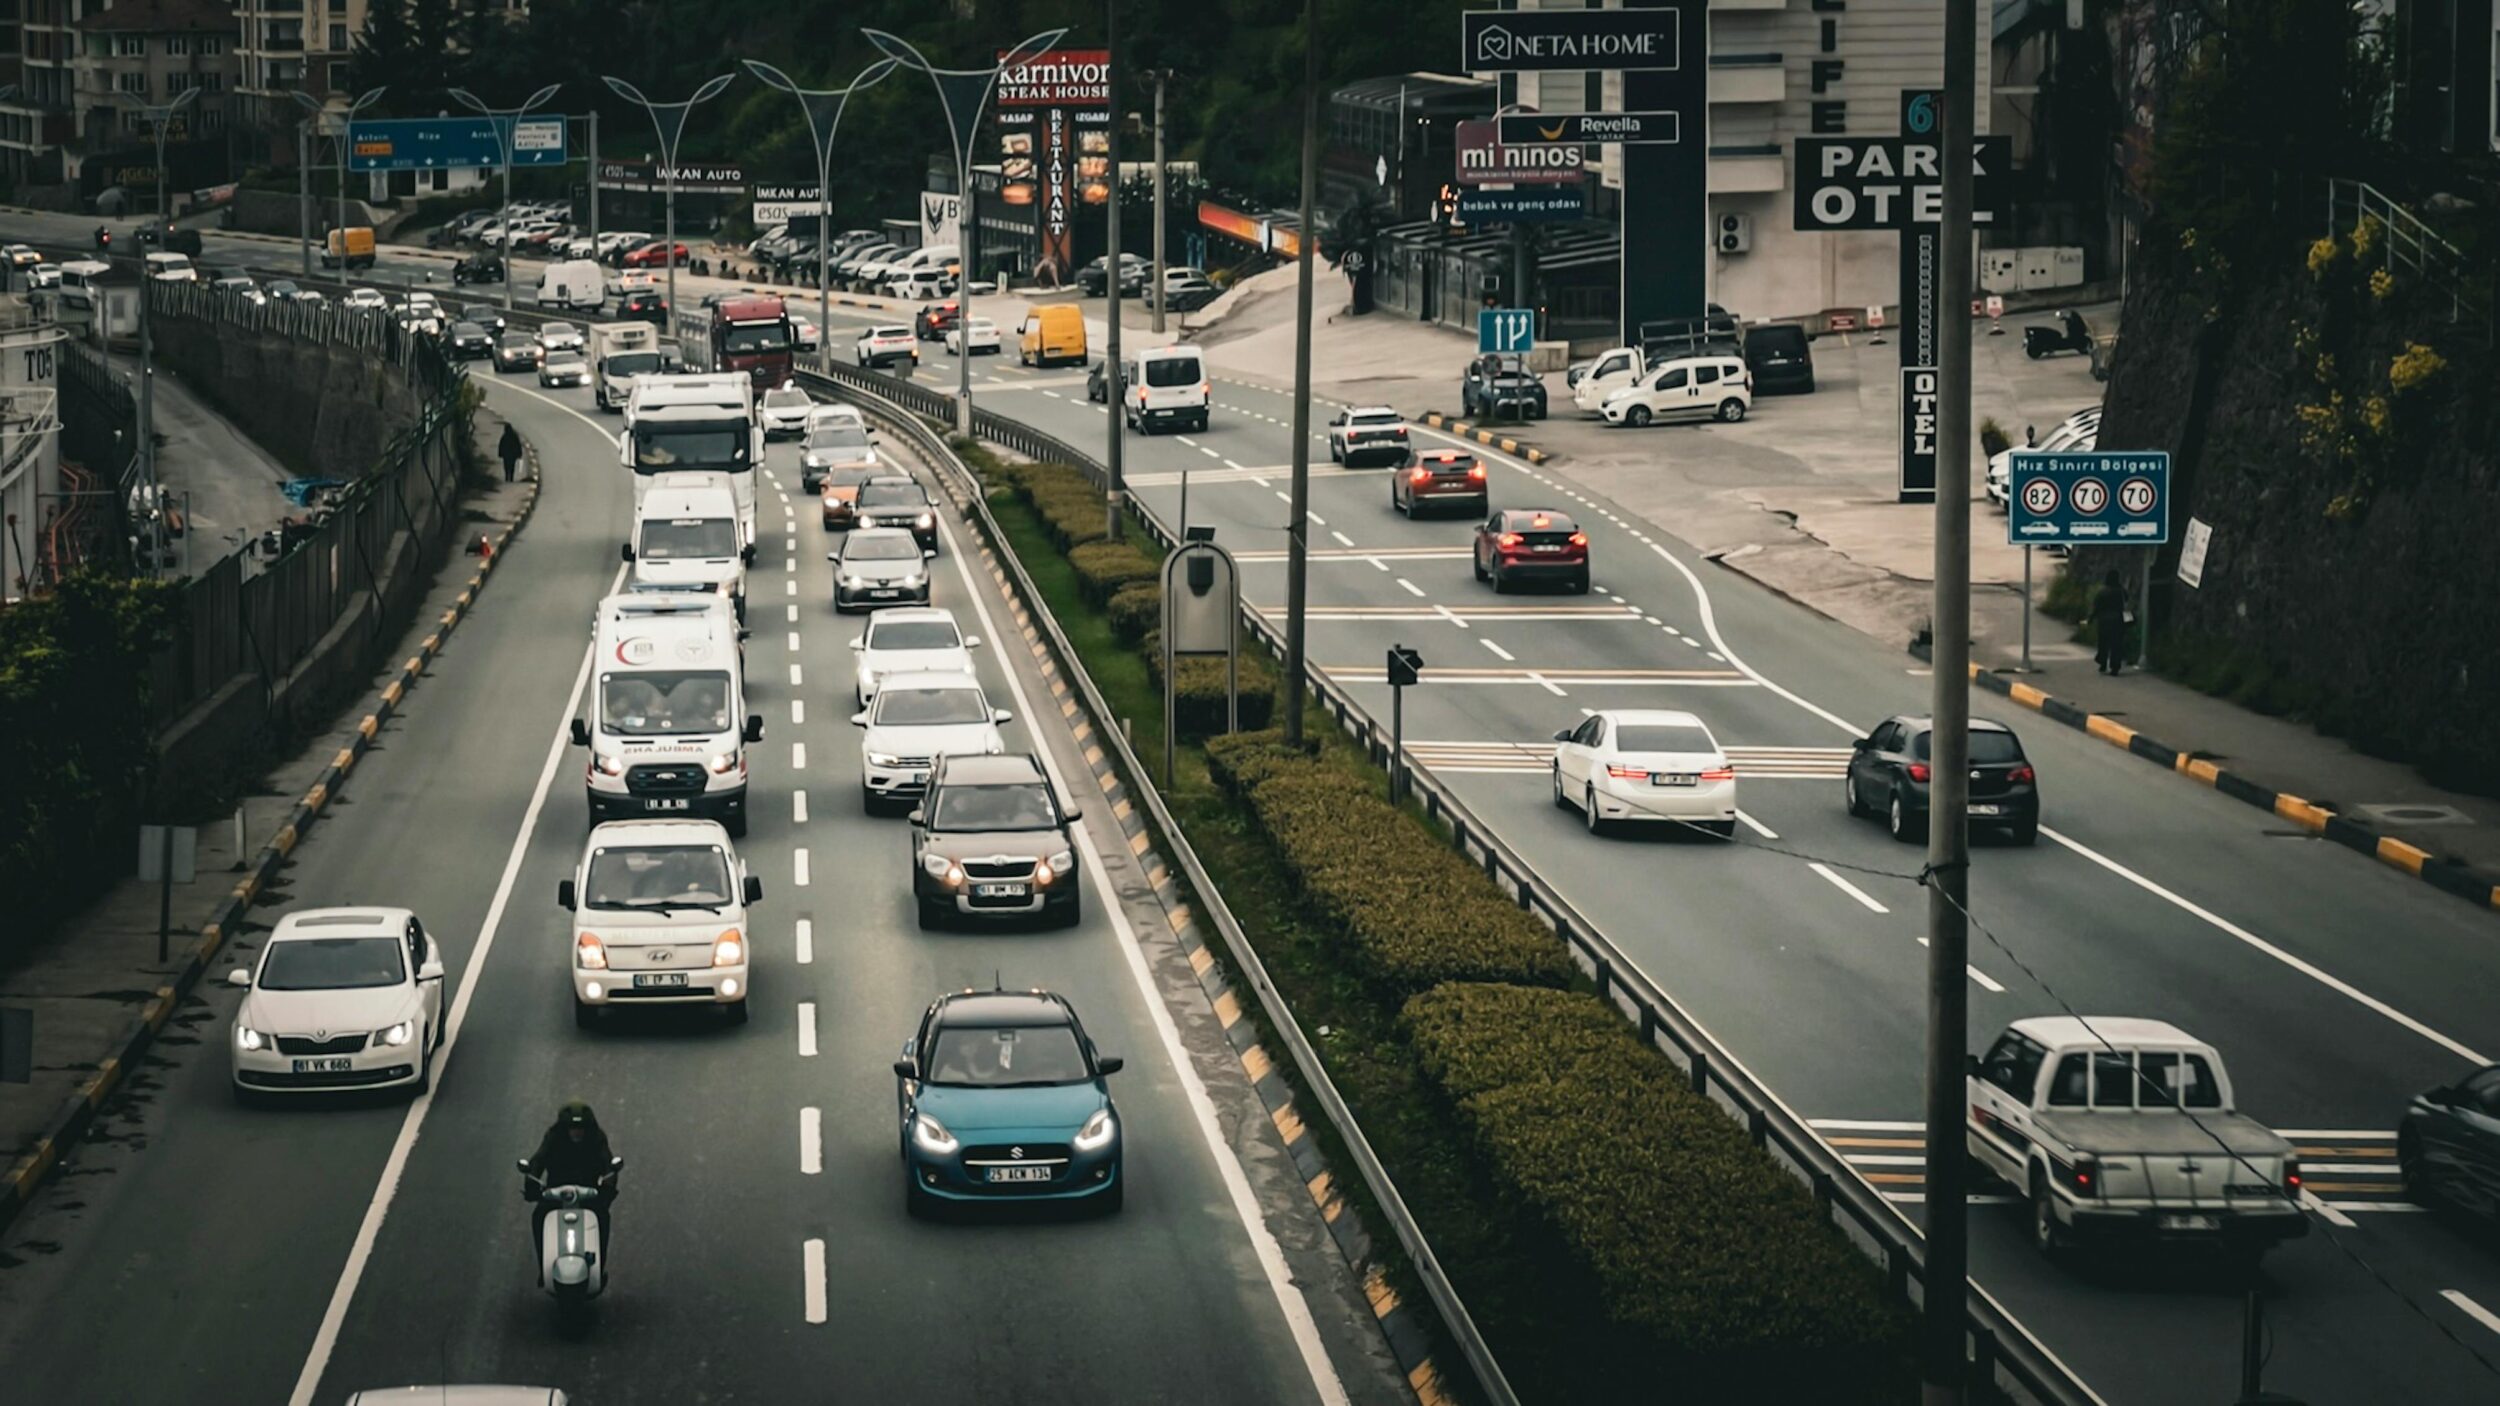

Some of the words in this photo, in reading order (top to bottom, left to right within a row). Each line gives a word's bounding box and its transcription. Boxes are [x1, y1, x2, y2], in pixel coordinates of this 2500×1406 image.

[1515, 34, 1578, 56] NETA
[1582, 33, 1657, 55] HOME
[999, 86, 1050, 99] STEAK
[1580, 117, 1641, 132] Revella
[1462, 142, 1495, 168] mi
[1503, 145, 1581, 168] ninos
[706, 170, 742, 181] AUTO
[1051, 109, 1064, 235] RESTAURANT
[798, 188, 822, 199] AUT
[758, 206, 789, 220] esas
[1463, 201, 1498, 211] bebek
[1501, 202, 1514, 210] ve
[1913, 373, 1937, 455] OTEL
[2017, 459, 2044, 472] Hız
[2100, 457, 2163, 474] Bölgesi
[2030, 488, 2052, 505] 82
[2078, 488, 2101, 505] 70
[2126, 487, 2150, 505] 70
